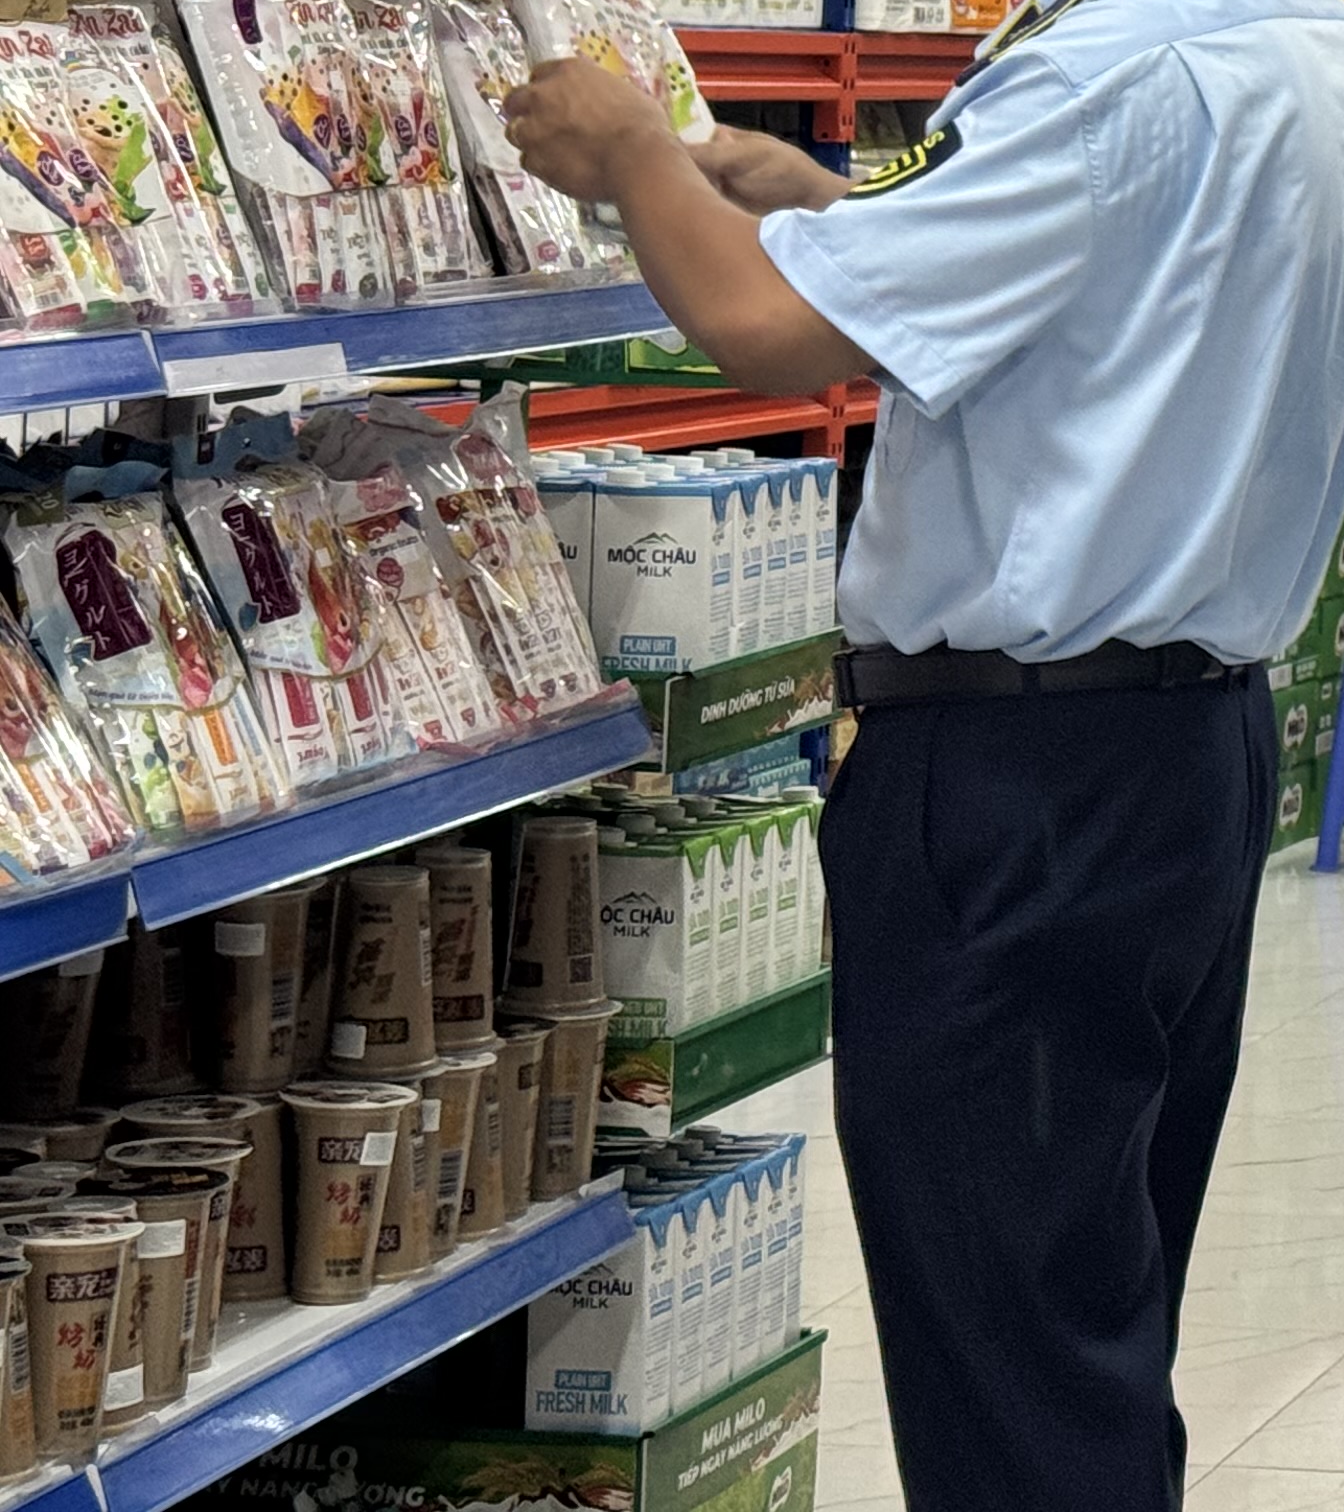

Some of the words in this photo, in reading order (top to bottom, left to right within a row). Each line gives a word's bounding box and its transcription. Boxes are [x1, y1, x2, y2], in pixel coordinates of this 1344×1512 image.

[558, 541, 577, 560] ÂU
[608, 544, 646, 565] MỘC
[652, 544, 696, 565] CHÂU
[637, 566, 672, 577] MILK
[701, 705, 727, 725] DINH
[600, 903, 624, 925] ỘC
[629, 903, 675, 925] CHÂU
[613, 925, 651, 938] MILK
[588, 1276, 633, 1296] CHÂU
[572, 1297, 609, 1309] MILK
[536, 1391, 586, 1414] FRESH
[590, 1393, 628, 1416] MILK
[701, 1417, 732, 1455] MUA
[734, 1397, 766, 1435] MILO
[259, 1442, 359, 1471] MILO
[700, 1449, 727, 1478] NGAY
